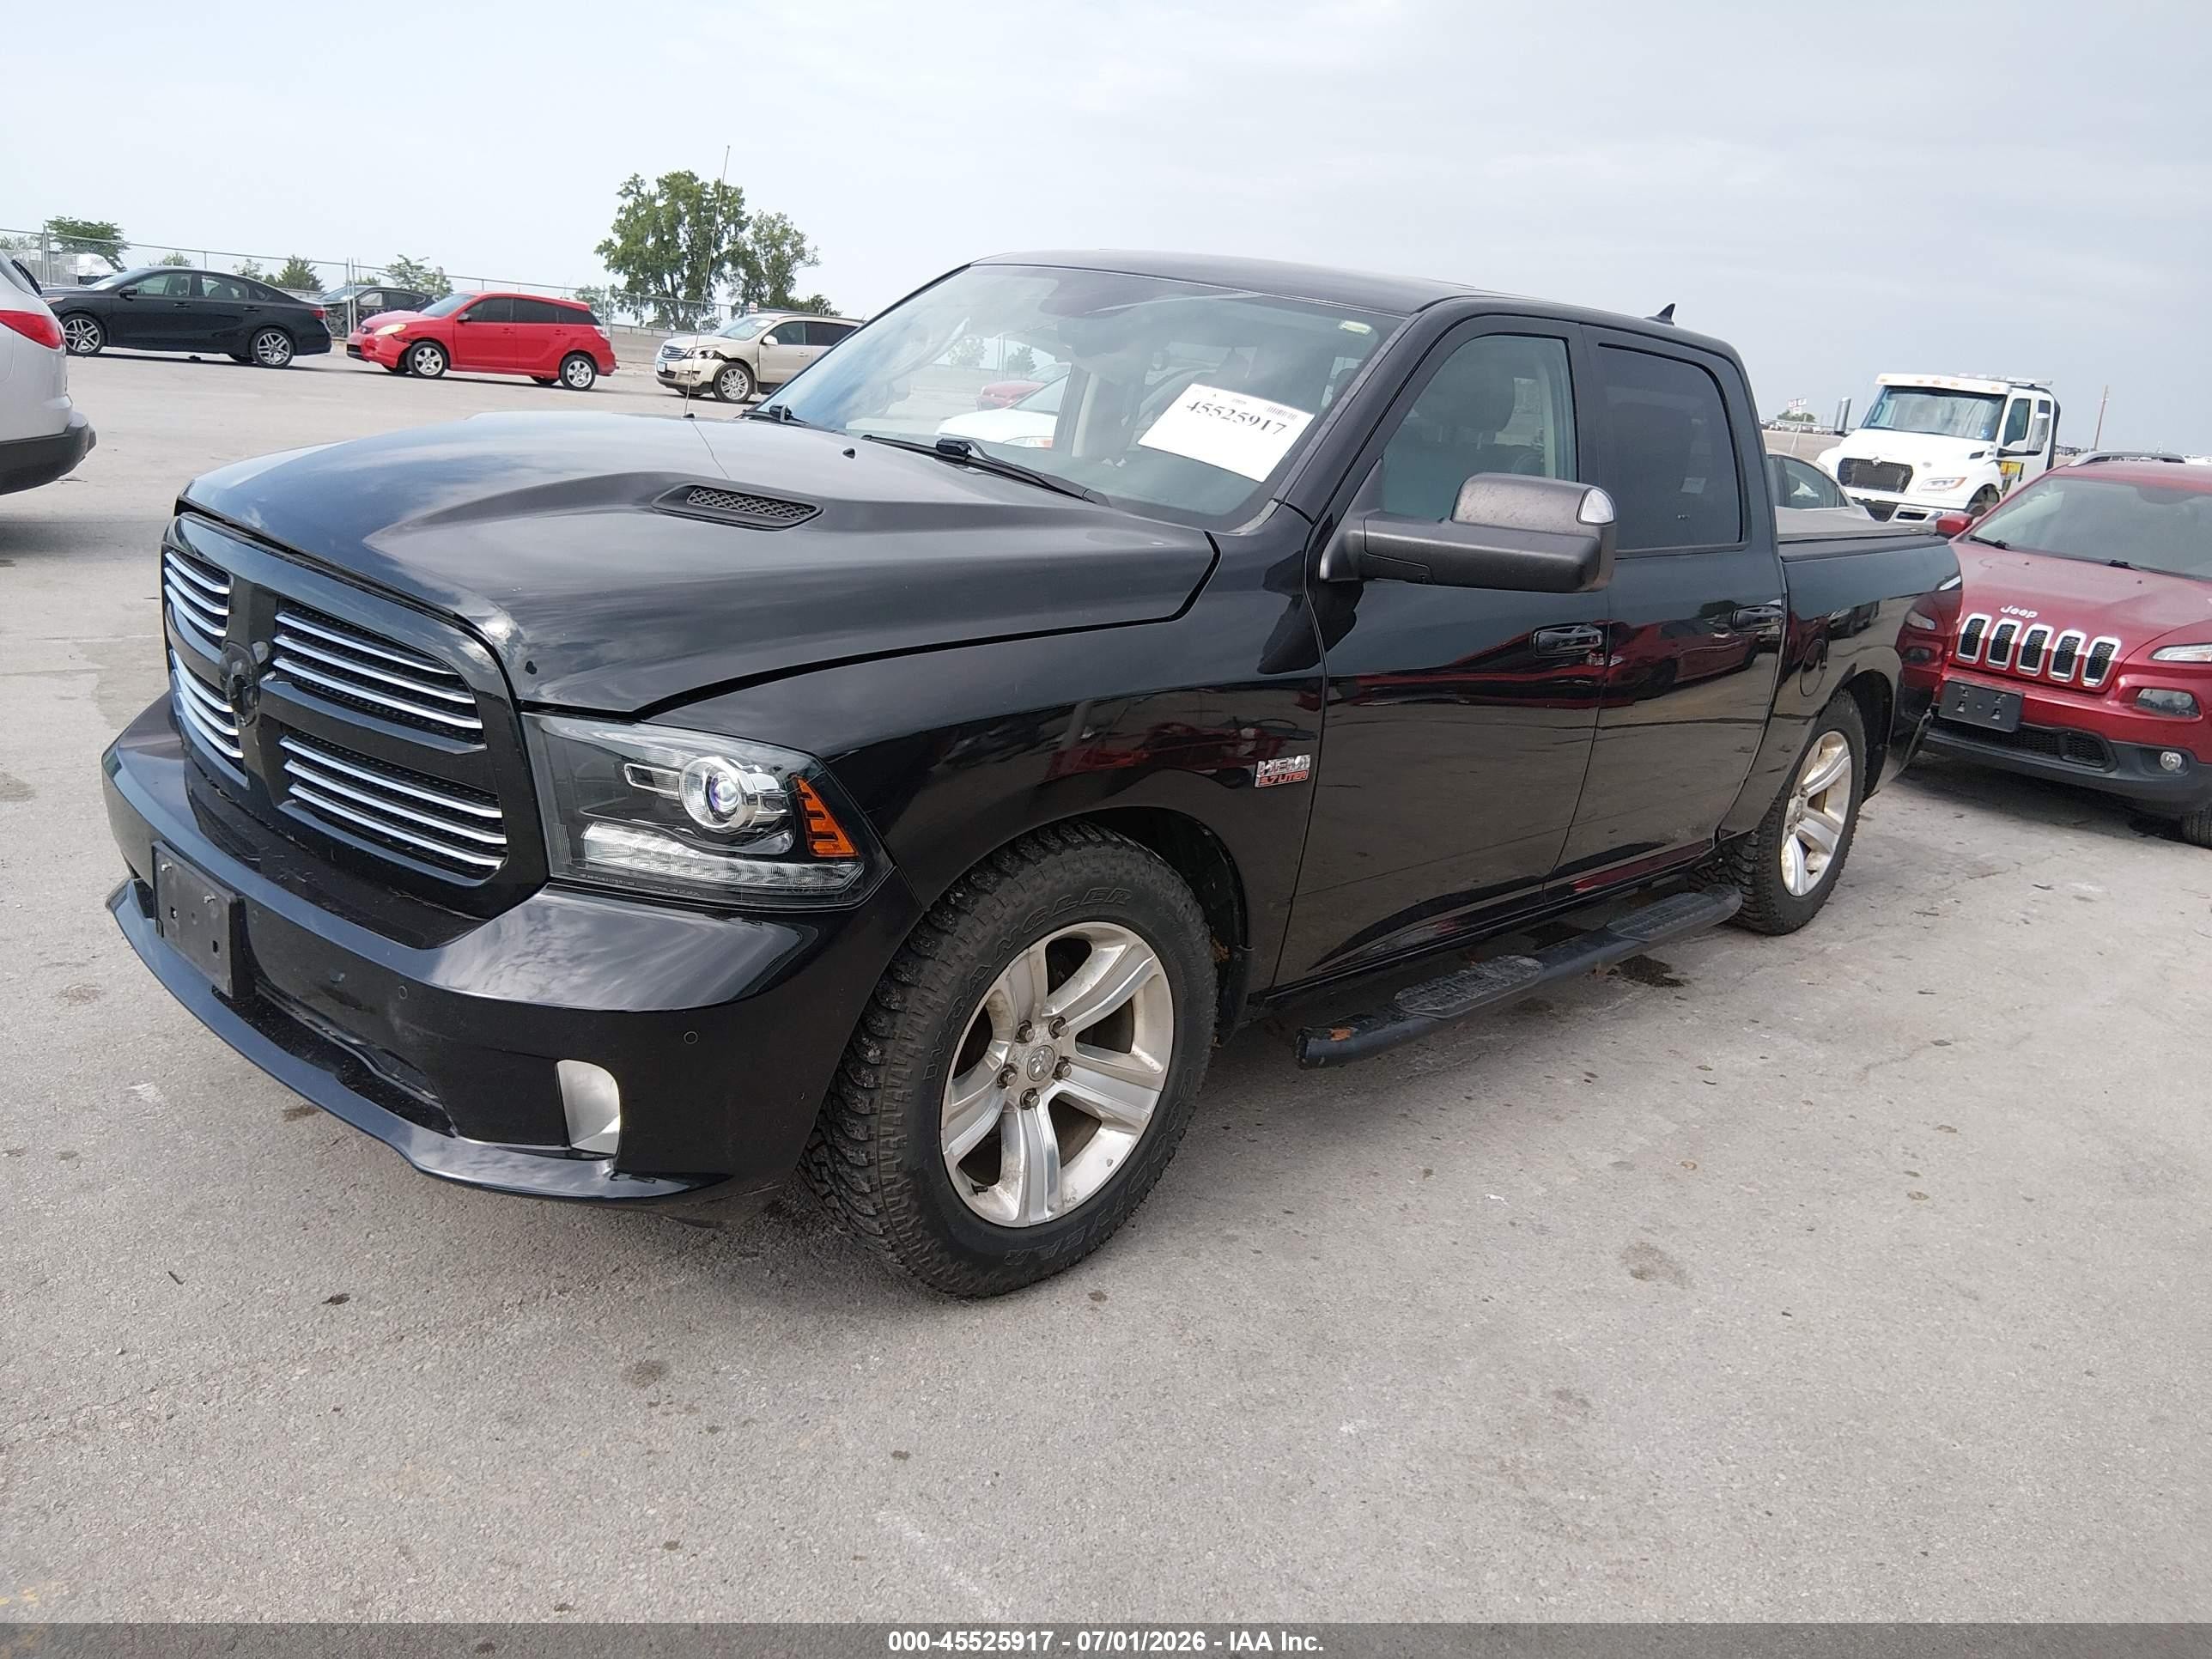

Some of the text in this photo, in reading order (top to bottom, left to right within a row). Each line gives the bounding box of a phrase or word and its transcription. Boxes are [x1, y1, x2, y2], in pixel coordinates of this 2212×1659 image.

[1186, 401, 1287, 434] 45525917
[2000, 605, 2038, 619] Jeep
[1256, 755, 1311, 775] HEMI
[1278, 770, 1307, 783] LITER
